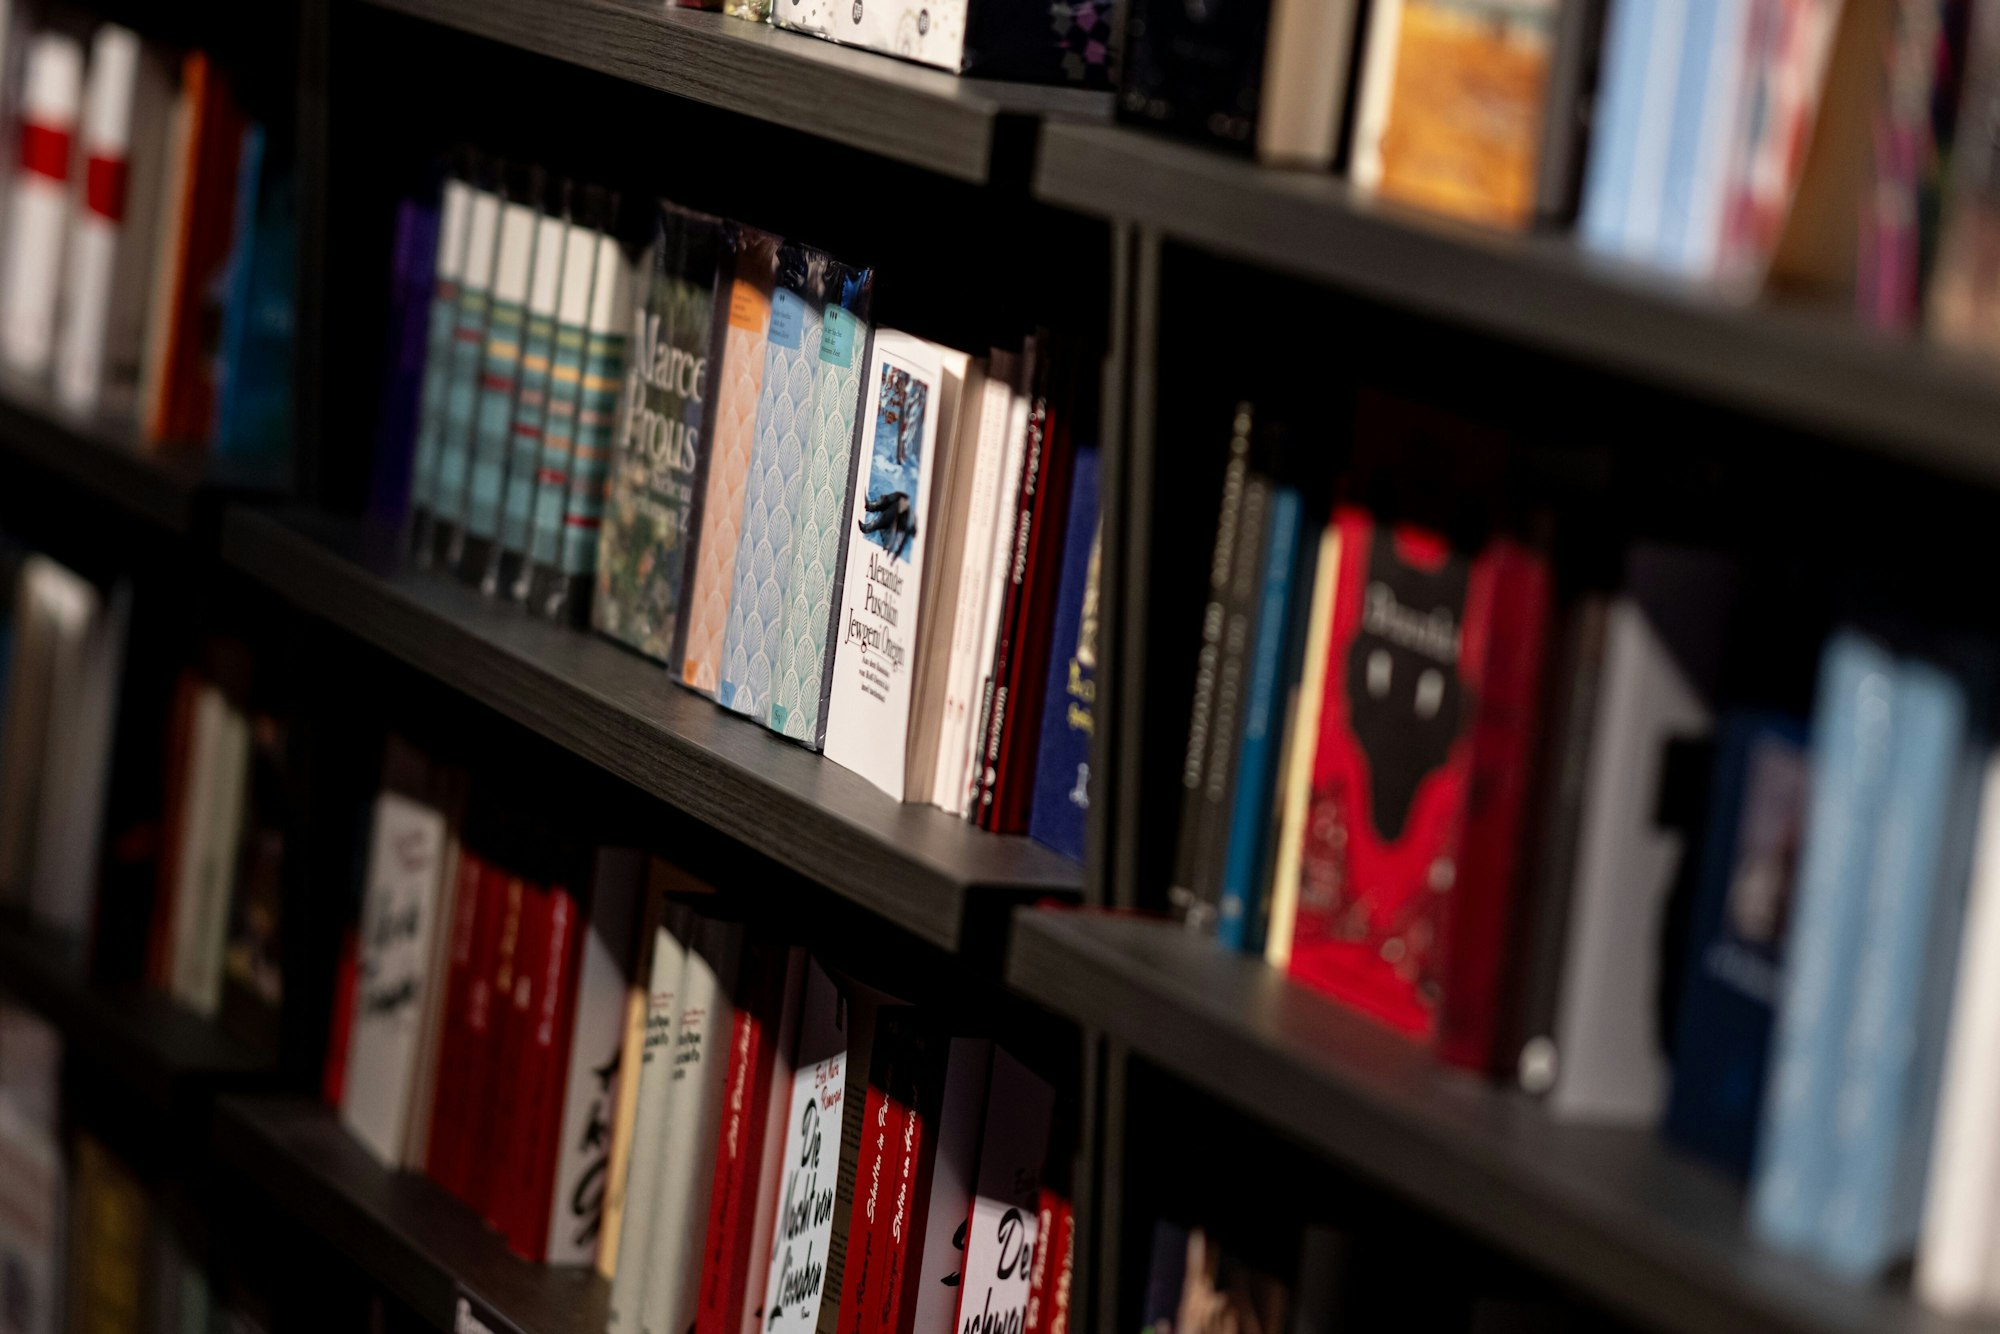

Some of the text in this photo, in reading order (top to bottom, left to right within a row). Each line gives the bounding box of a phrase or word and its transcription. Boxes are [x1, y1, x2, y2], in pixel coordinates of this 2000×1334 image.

[864, 583, 898, 627] Puschkin
[866, 551, 904, 596] Alexander
[845, 608, 906, 673] Jewgeni Onegin
[801, 1098, 822, 1169] Die
[867, 1154, 882, 1224] Schatten
[877, 1132, 884, 1151] im
[893, 1182, 907, 1244] Station
[902, 1155, 911, 1179] am
[774, 1171, 818, 1260] Nacht
[813, 1187, 832, 1228] von
